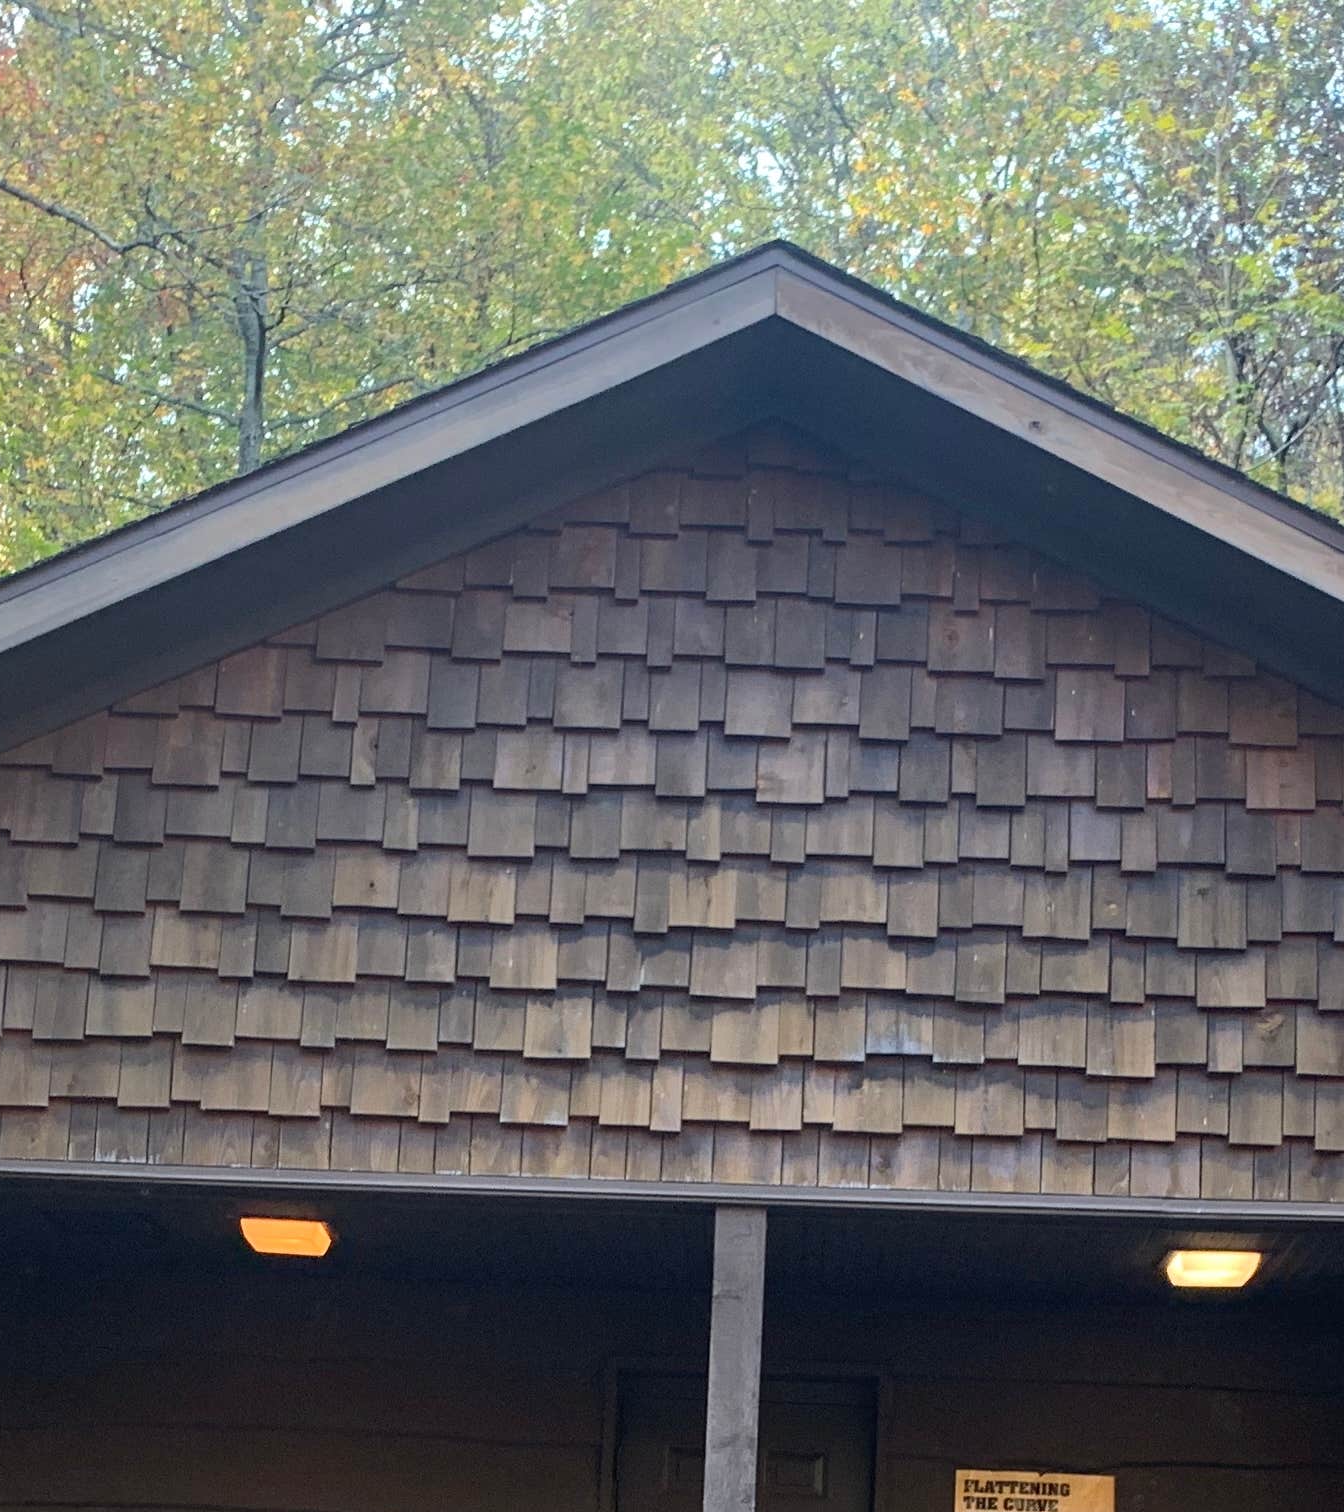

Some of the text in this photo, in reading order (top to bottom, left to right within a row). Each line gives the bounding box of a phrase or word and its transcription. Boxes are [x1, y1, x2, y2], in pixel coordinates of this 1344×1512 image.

[963, 1479, 1070, 1496] FLATTENING
[963, 1496, 1059, 1512] THE CURVE
